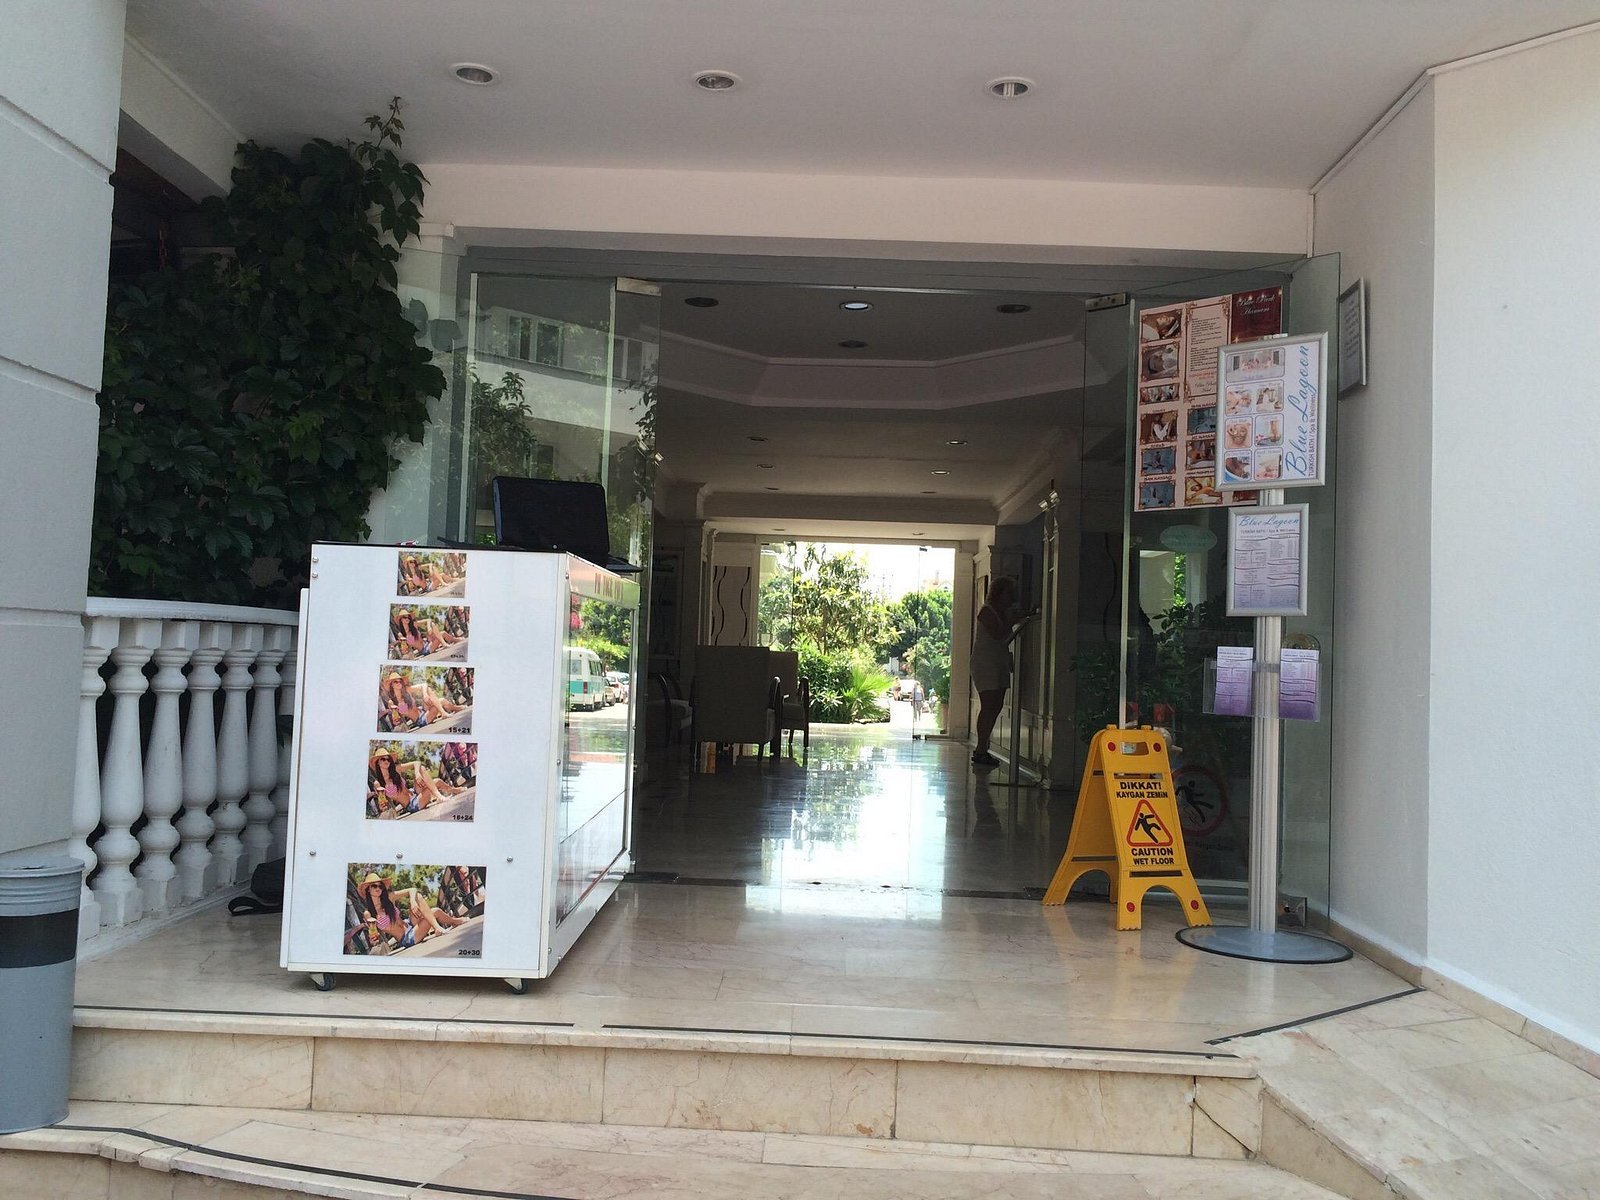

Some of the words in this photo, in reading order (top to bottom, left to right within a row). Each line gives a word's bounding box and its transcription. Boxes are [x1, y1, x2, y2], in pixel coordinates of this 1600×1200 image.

[1287, 345, 1317, 422] Lagoon
[1285, 426, 1308, 476] Blue
[1239, 515, 1262, 527] Blue
[1263, 513, 1299, 529] Lagoon
[448, 726, 471, 734] 15+21
[1116, 791, 1146, 799] KAYGAN
[1131, 847, 1174, 857] CAUTION
[1133, 857, 1150, 866] WET
[1150, 857, 1175, 866] FLOOR
